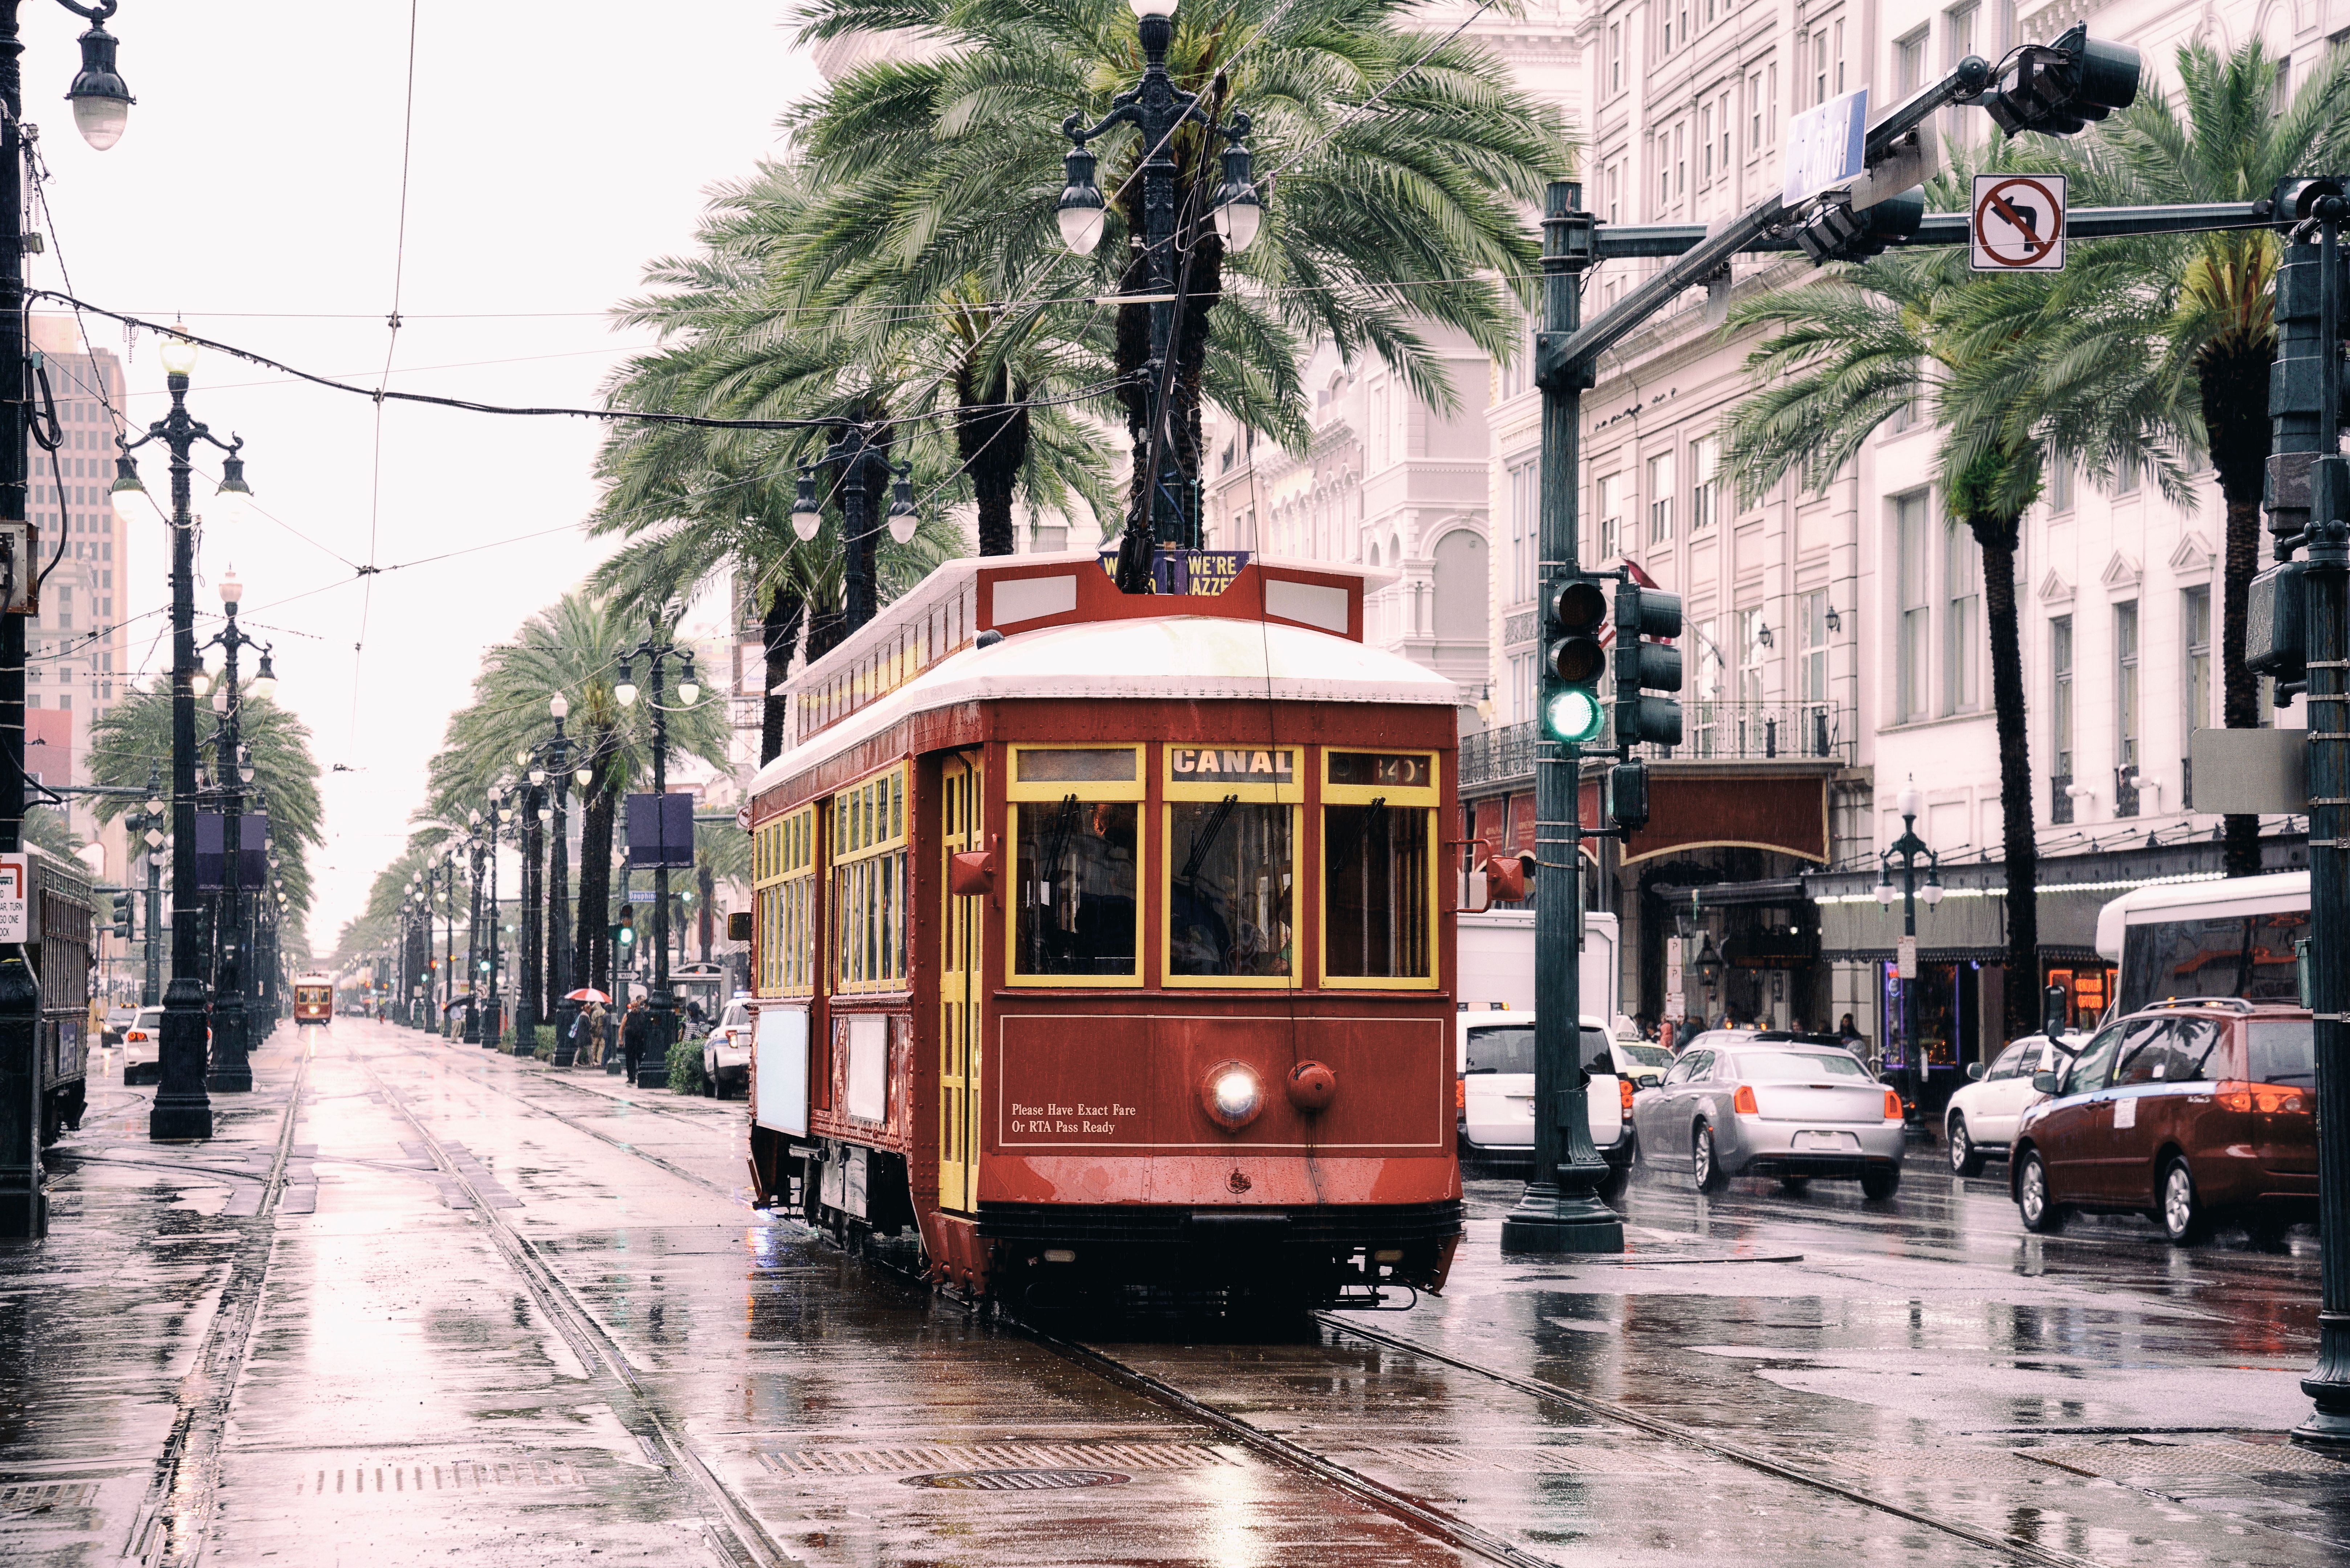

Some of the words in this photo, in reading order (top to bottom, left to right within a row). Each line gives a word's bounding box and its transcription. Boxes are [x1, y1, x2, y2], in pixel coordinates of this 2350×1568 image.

[1803, 101, 1851, 192] Canal
[1188, 556, 1236, 574] WE'RE
[1173, 749, 1292, 772] CANAL
[8, 915, 19, 923] ONE
[1012, 1103, 1043, 1115] Please
[1047, 1103, 1073, 1115] Have
[1078, 1104, 1108, 1115] Exact
[1112, 1104, 1136, 1115] Fare
[1012, 1120, 1025, 1132] Or
[1029, 1120, 1052, 1132] RTA
[1056, 1121, 1078, 1132] Pass
[1083, 1121, 1115, 1134] Ready
